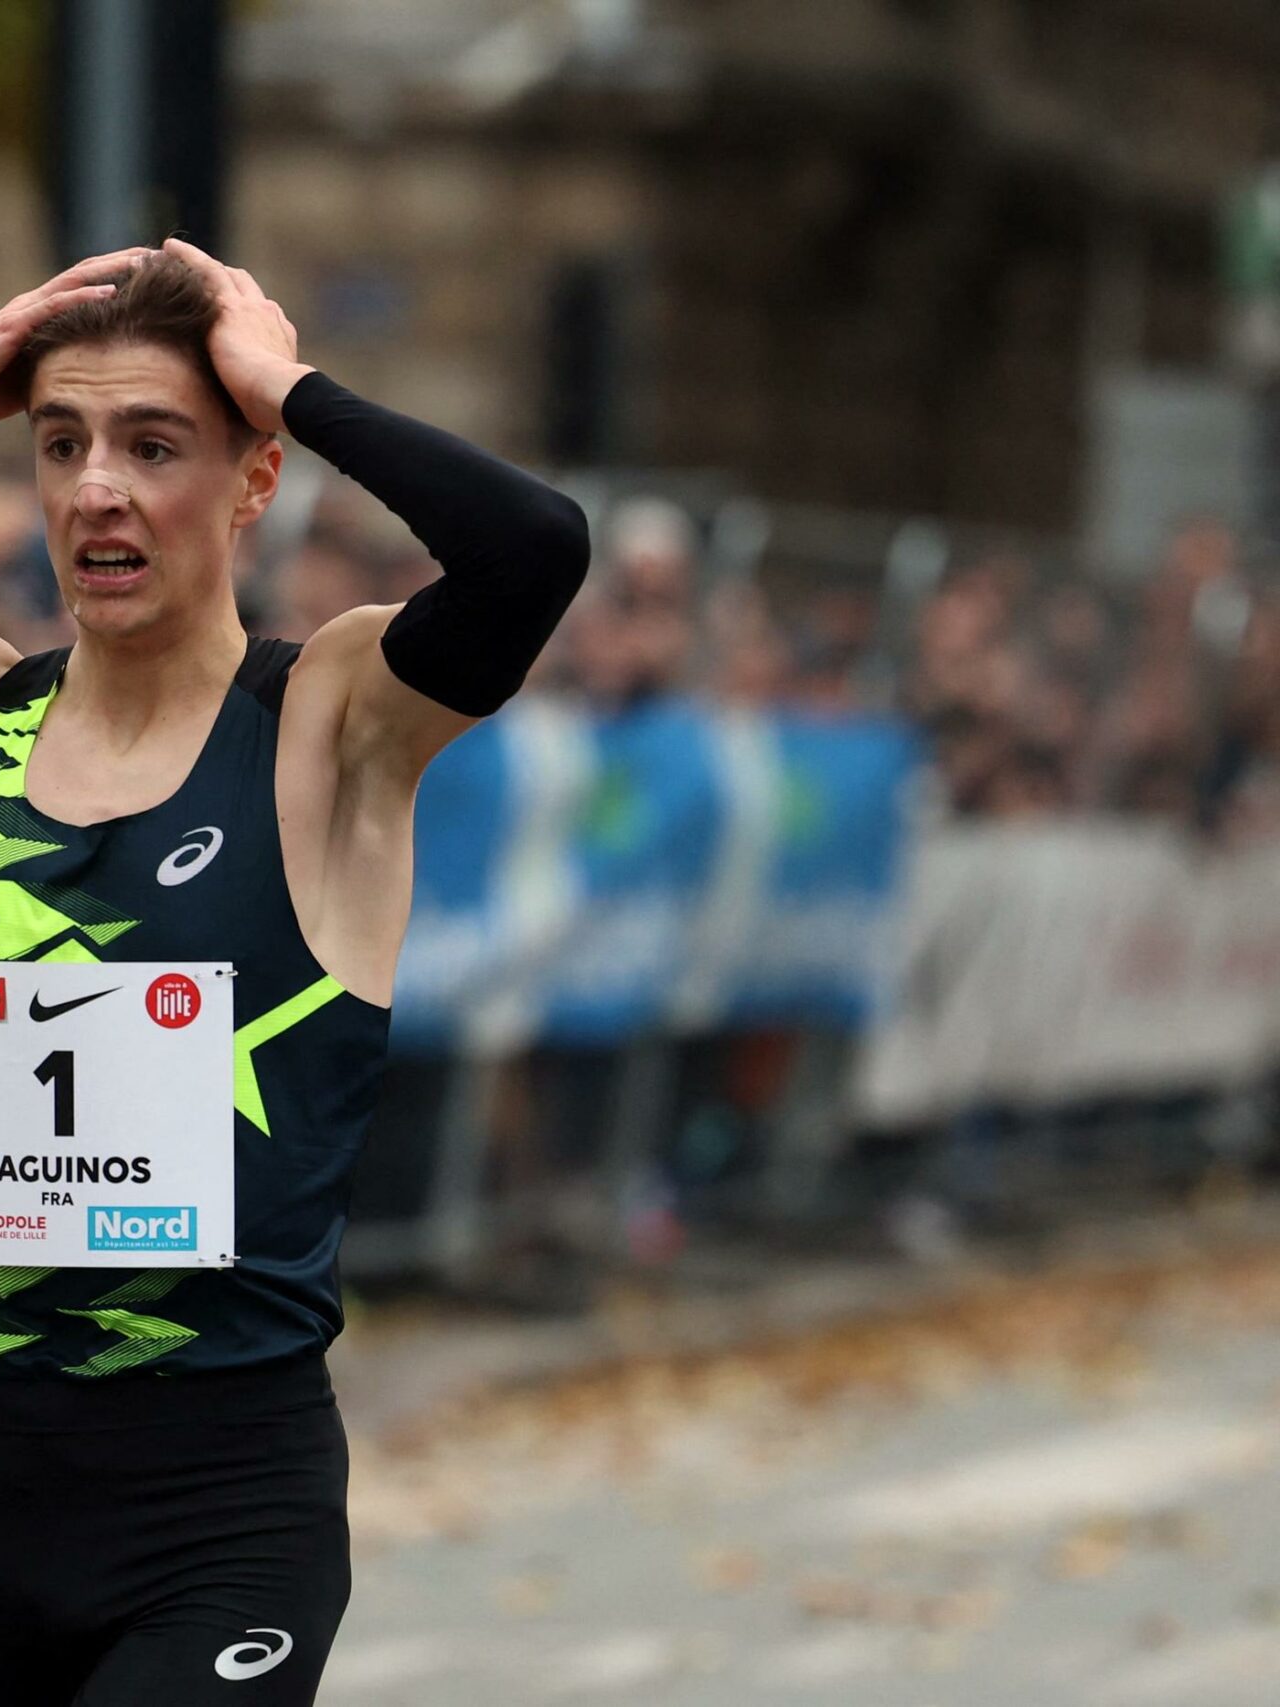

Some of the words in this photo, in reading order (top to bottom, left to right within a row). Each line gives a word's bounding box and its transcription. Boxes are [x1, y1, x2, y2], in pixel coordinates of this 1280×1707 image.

[33, 1050, 75, 1137] 1
[41, 1191, 74, 1206] FRA
[10, 1231, 21, 1239] DE
[23, 1231, 47, 1240] LILLE
[94, 1209, 190, 1240] Nord
